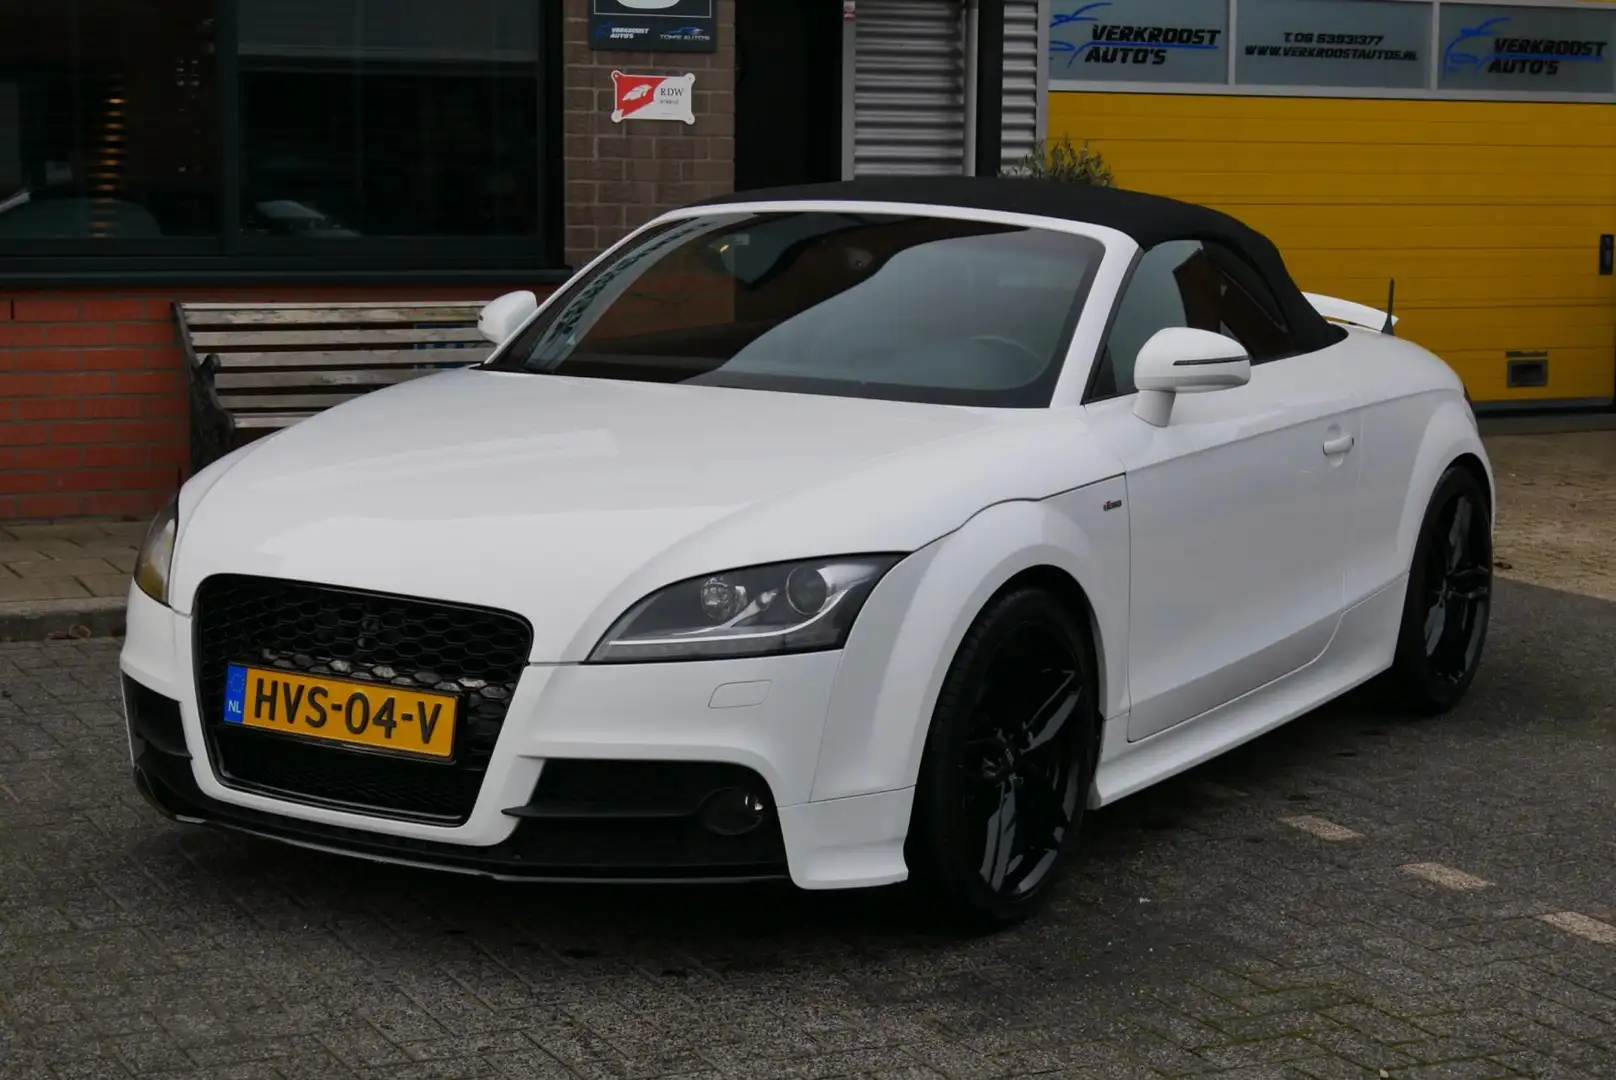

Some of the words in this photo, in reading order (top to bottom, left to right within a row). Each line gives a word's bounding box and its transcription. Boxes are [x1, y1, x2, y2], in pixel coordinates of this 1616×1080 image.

[1092, 25, 1221, 45] VERKROOST
[1085, 46, 1167, 66] AUTO'S
[1493, 37, 1608, 57] VERKROOST
[1488, 59, 1560, 75] AUTO'S
[660, 88, 684, 97] RDW
[228, 700, 242, 714] NL
[254, 678, 443, 745] HVS-04-V
